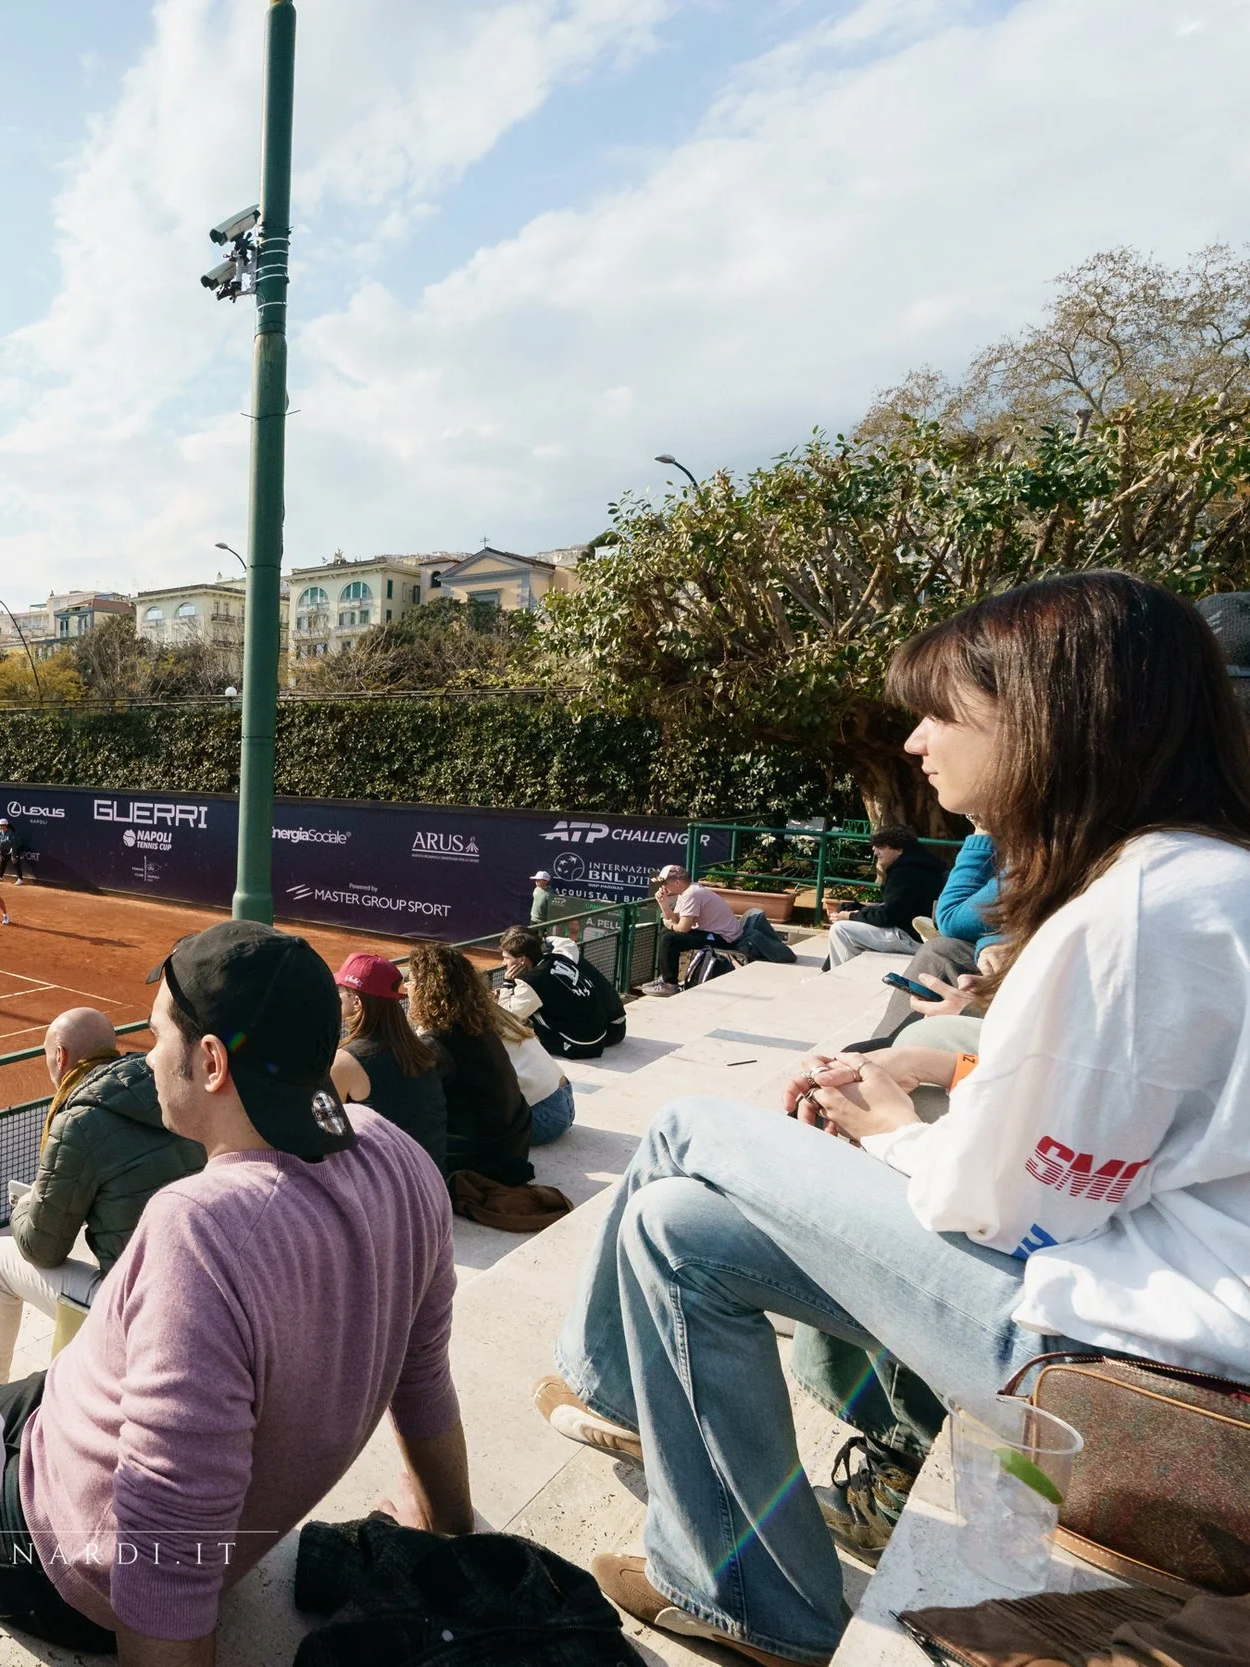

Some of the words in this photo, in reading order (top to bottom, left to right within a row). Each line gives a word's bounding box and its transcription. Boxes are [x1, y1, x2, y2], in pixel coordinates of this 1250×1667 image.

[22, 805, 65, 818] LEXUS
[93, 799, 208, 829] GUERRI
[136, 829, 172, 843] NAPOLI
[272, 825, 347, 845] nergiaSociale
[412, 831, 464, 853] ARUS
[539, 820, 610, 844] ATP
[611, 828, 711, 847] CHALLENGR
[136, 840, 158, 850] TENNIS
[159, 843, 172, 851] CUP
[588, 870, 625, 883] BNL
[314, 888, 359, 905] MASTER
[361, 894, 407, 912] GROUP
[408, 901, 451, 918] SPORT
[585, 917, 596, 926] A.
